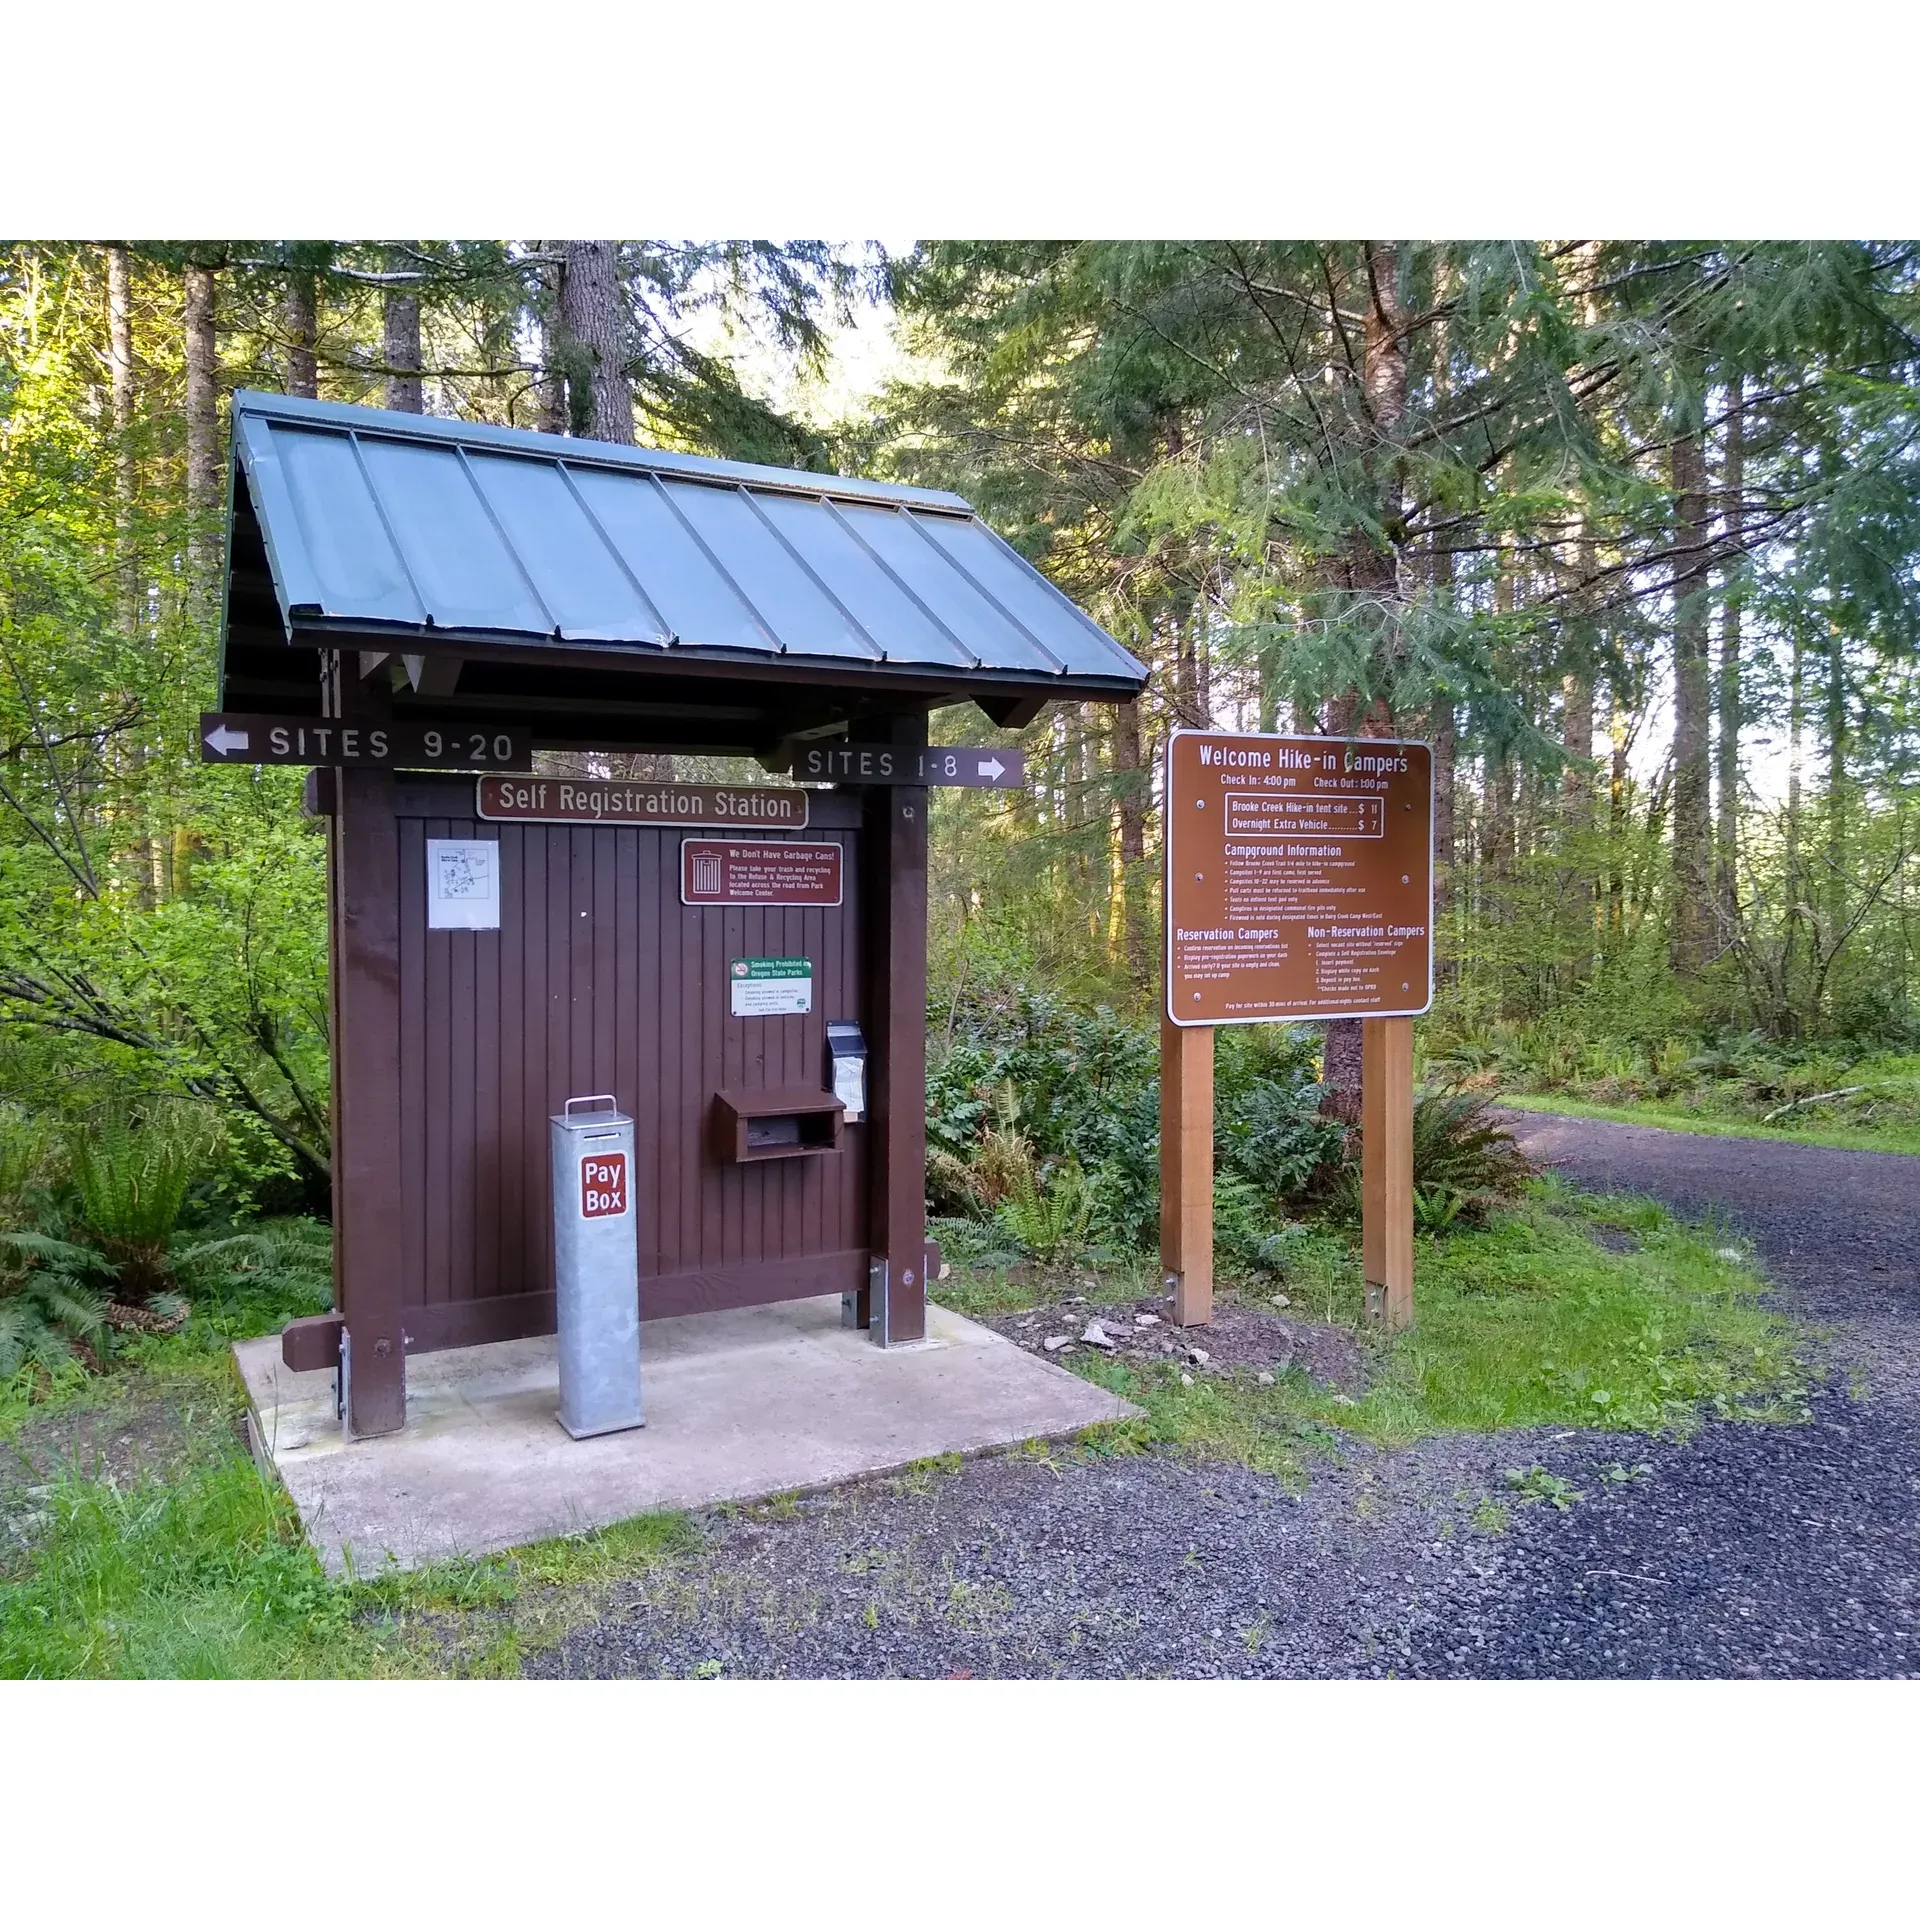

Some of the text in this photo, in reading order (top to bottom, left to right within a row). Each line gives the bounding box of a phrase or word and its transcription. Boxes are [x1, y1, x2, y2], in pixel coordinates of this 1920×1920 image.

[270, 727, 512, 760] SITES 9-20
[808, 750, 956, 776] SITES 1-8
[1200, 745, 1407, 777] Welcome Hike-in Campers
[1221, 774, 1296, 789] Check In: 4:00 pm
[1314, 777, 1338, 788] Check
[1340, 778, 1358, 788] Out:
[1376, 780, 1388, 792] pm
[500, 783, 790, 818] Self Registration Station
[1232, 801, 1259, 812] Brooke
[1262, 802, 1284, 812] Creek
[1286, 802, 1314, 813] Hike-in
[1316, 803, 1332, 813] tent
[1358, 803, 1365, 814] $
[1371, 804, 1378, 814] 11
[1232, 818, 1271, 832] Overnight
[1274, 819, 1296, 829] Extra
[1358, 819, 1365, 831] $
[1372, 820, 1378, 830] 7
[730, 850, 740, 858] We
[743, 850, 760, 858] Don't
[784, 851, 812, 861] Garbage
[815, 852, 834, 860] Cans!
[1225, 843, 1342, 859] Campground Information
[1177, 928, 1279, 942] Reservation Campers
[1308, 925, 1425, 939] Non-Reservation Campers
[586, 1162, 620, 1188] Pay
[586, 1190, 622, 1212] Box
